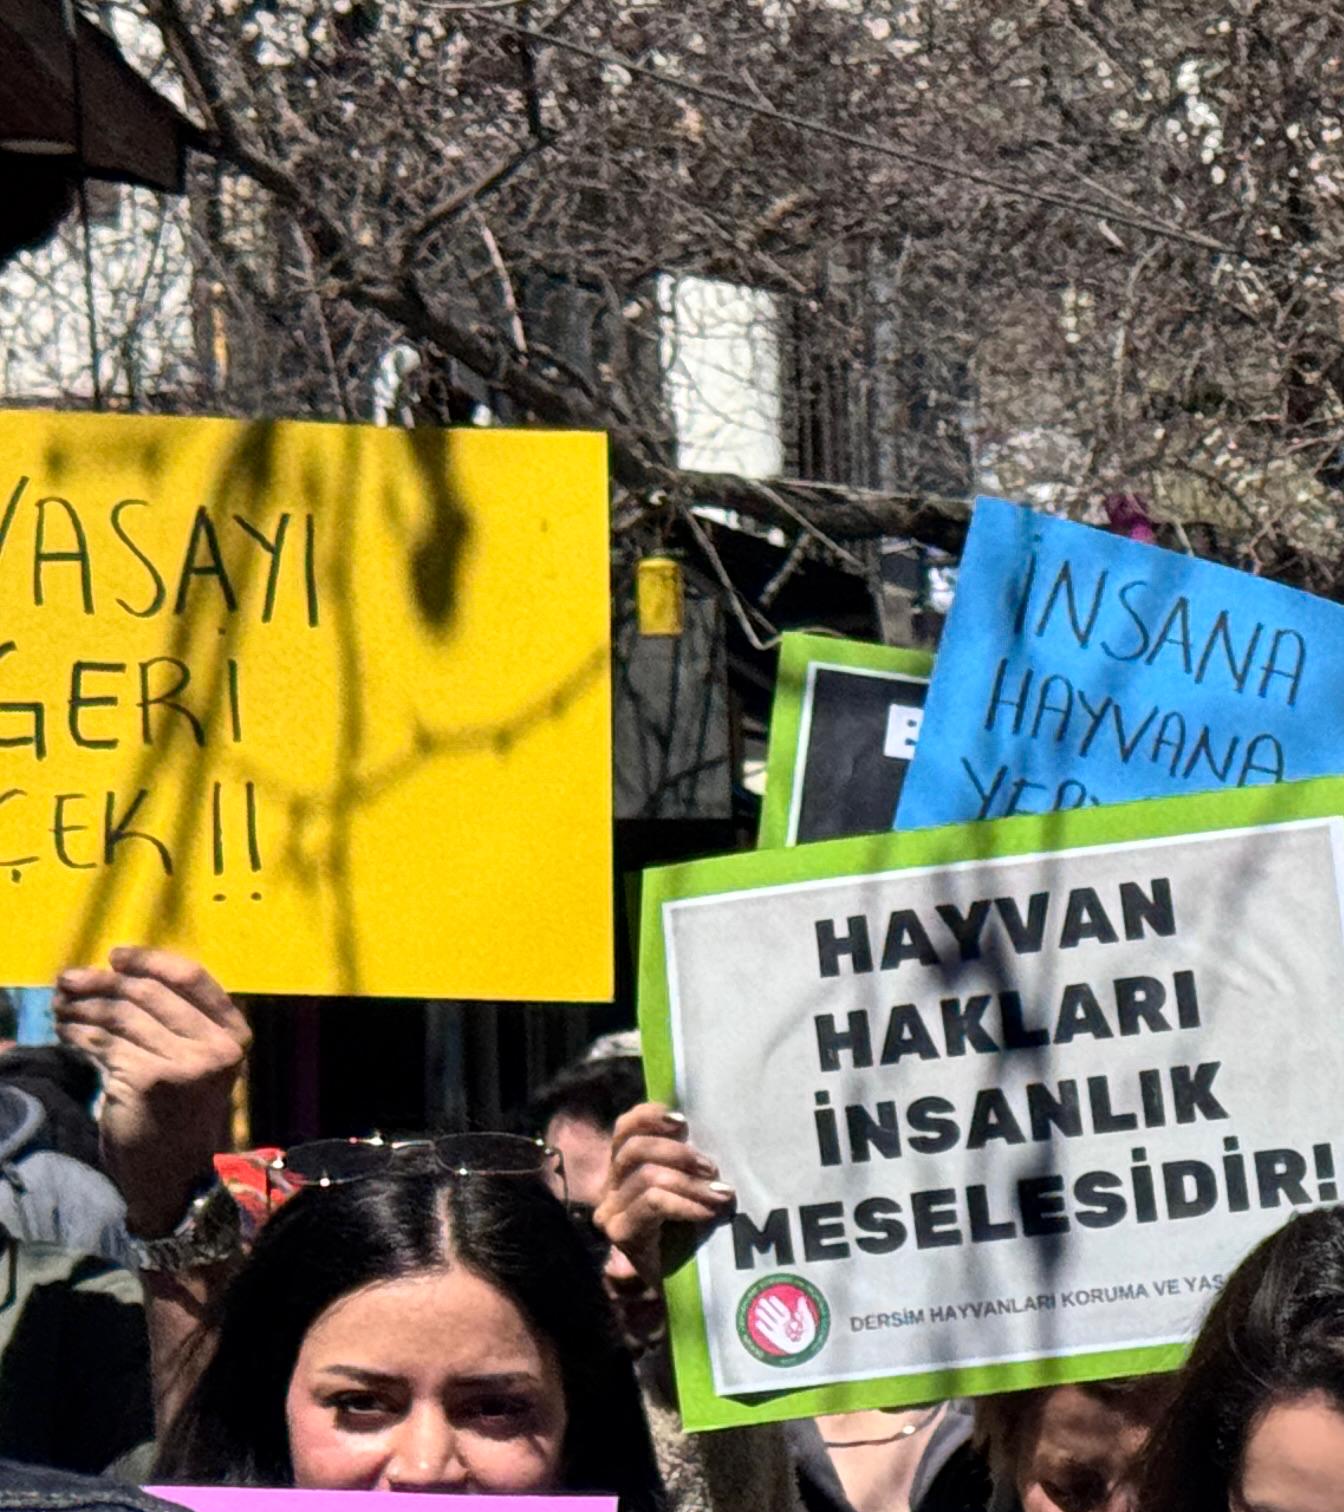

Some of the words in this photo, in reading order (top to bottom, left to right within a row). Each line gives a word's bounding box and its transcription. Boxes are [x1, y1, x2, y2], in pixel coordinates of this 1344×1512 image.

[1013, 534, 1307, 706] İNSANA
[985, 657, 1285, 787] HAYVANA
[813, 877, 1177, 978] HAYVAN
[813, 970, 1201, 1073] HAKLARI
[813, 1061, 1228, 1167] İNSANLIK
[731, 1135, 1342, 1271] MESELESİDİR!
[850, 1308, 926, 1333] DERSİM
[930, 1294, 1057, 1322] HAYVANLARI
[1060, 1282, 1149, 1309] KORUMA
[1153, 1277, 1182, 1297] VE
